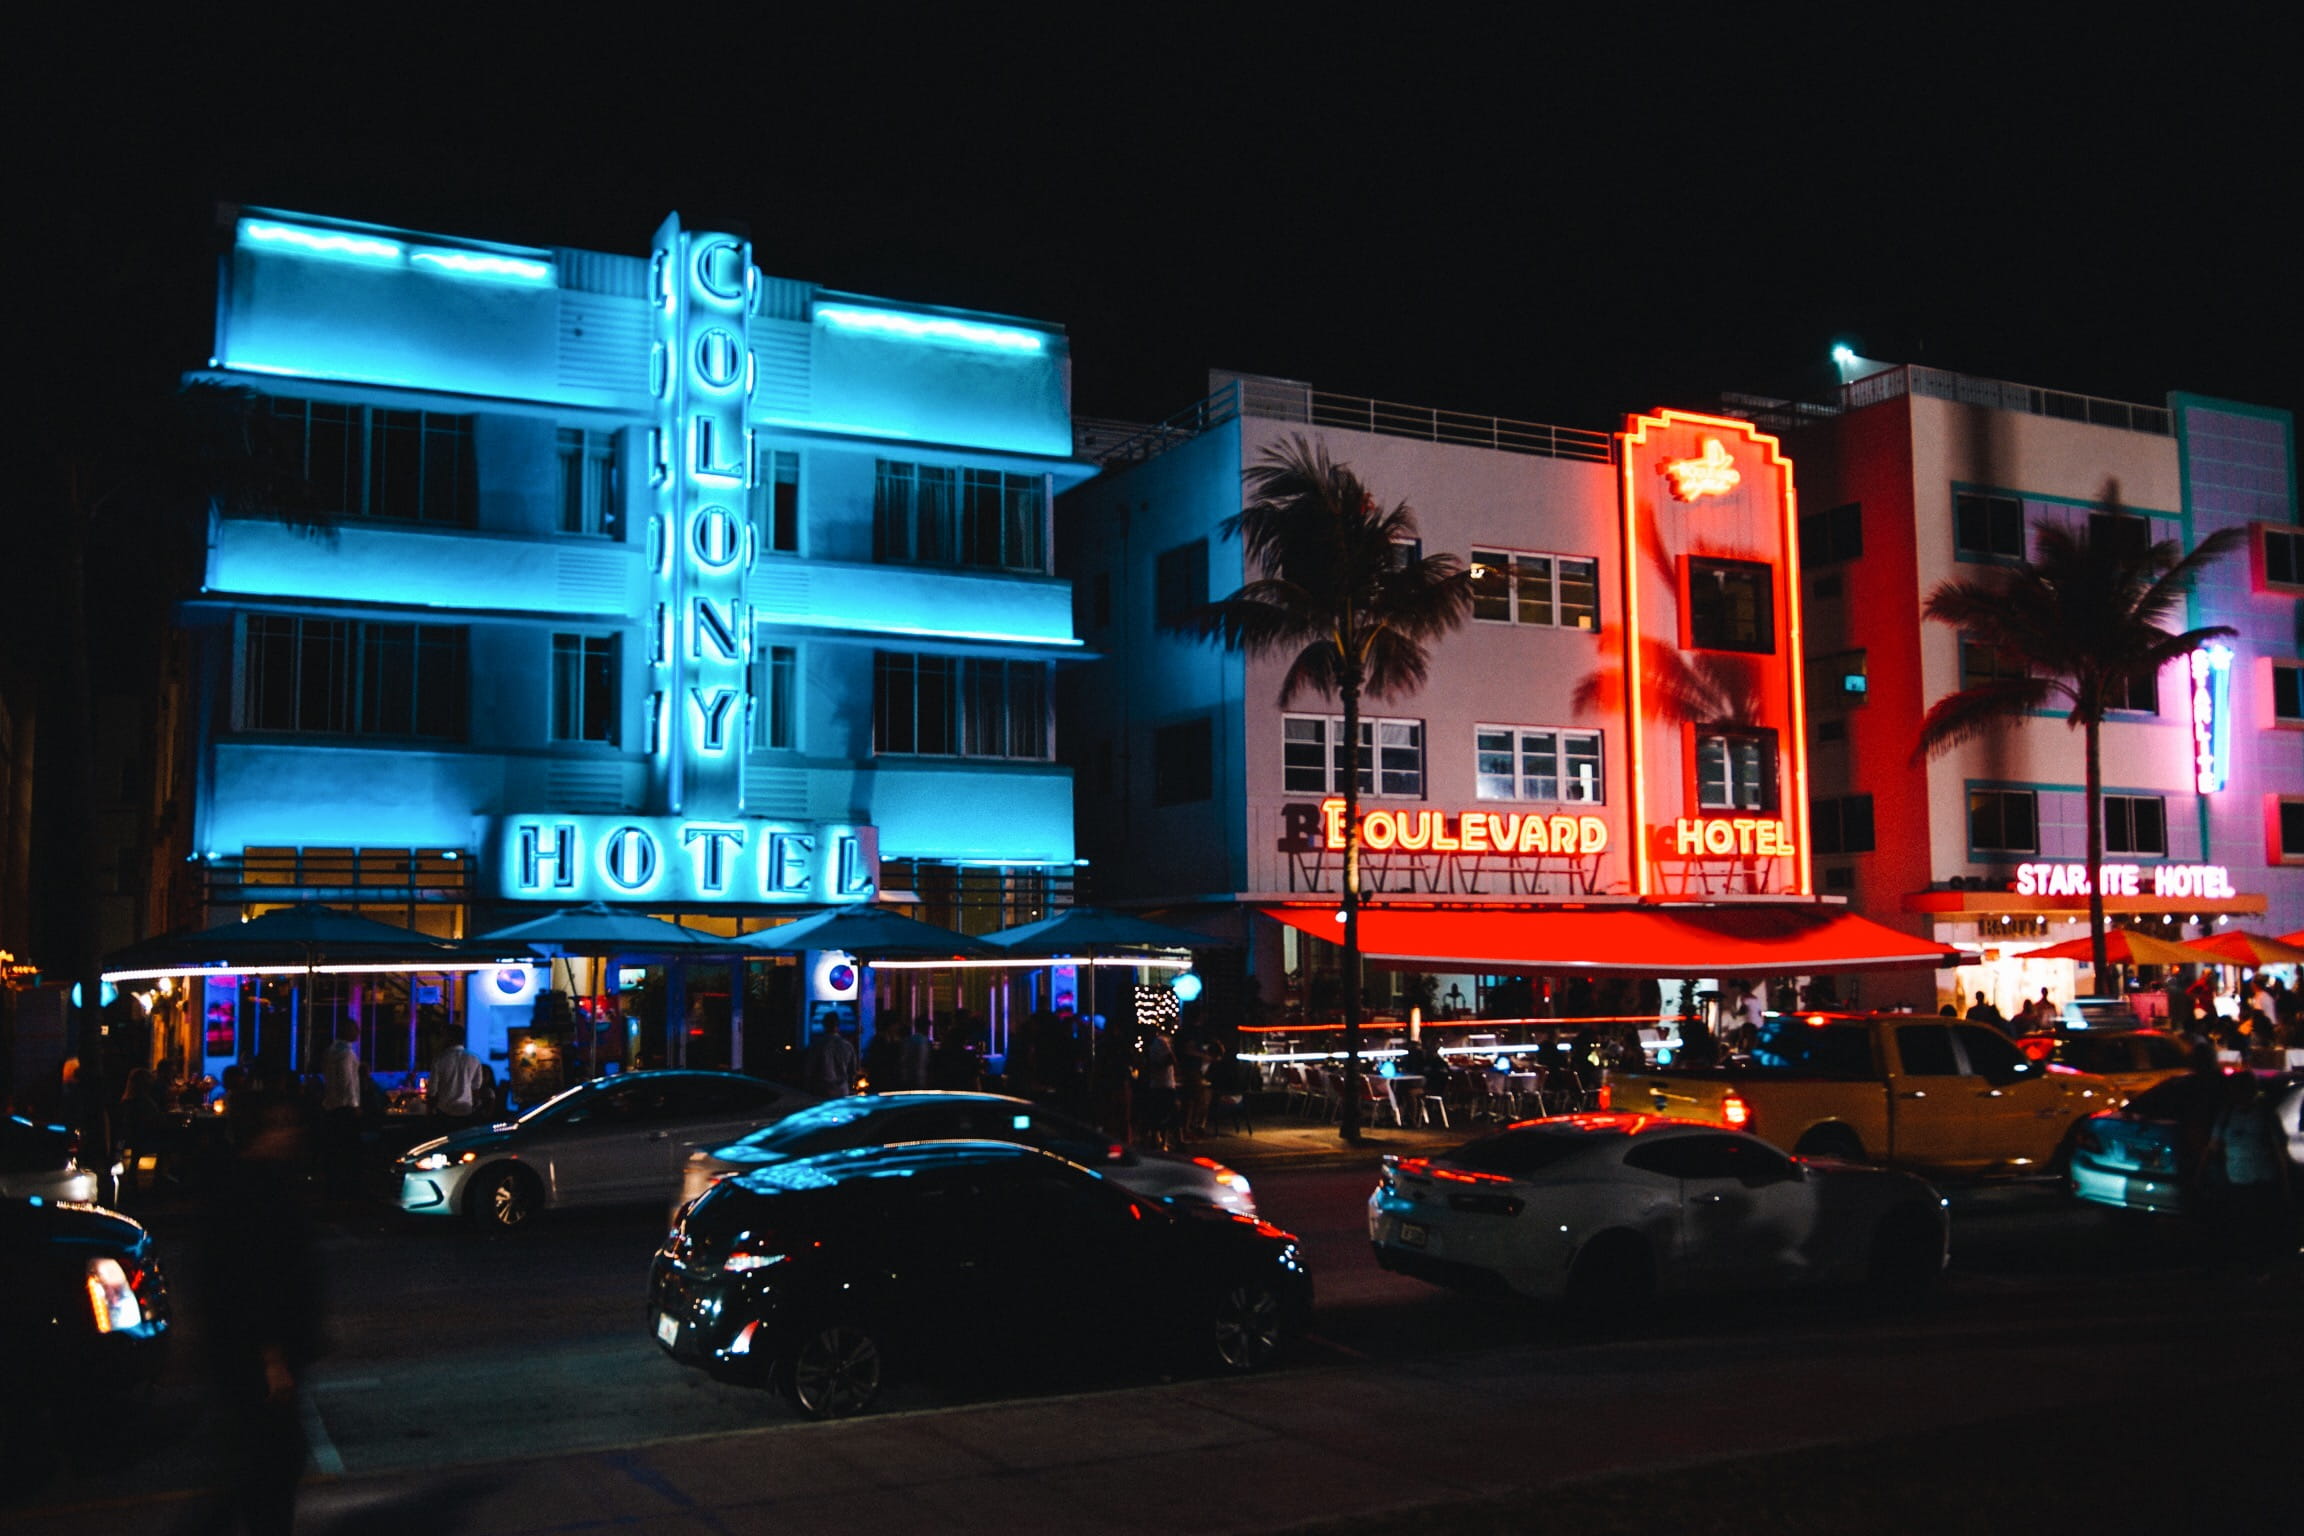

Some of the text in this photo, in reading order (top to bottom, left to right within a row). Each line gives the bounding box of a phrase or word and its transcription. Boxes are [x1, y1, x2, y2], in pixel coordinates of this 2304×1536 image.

[691, 239, 744, 751] COLONY
[518, 824, 875, 896] HOTEL
[1676, 817, 1795, 857] HOTEL
[2016, 863, 2236, 898] STARITE HOTEL
